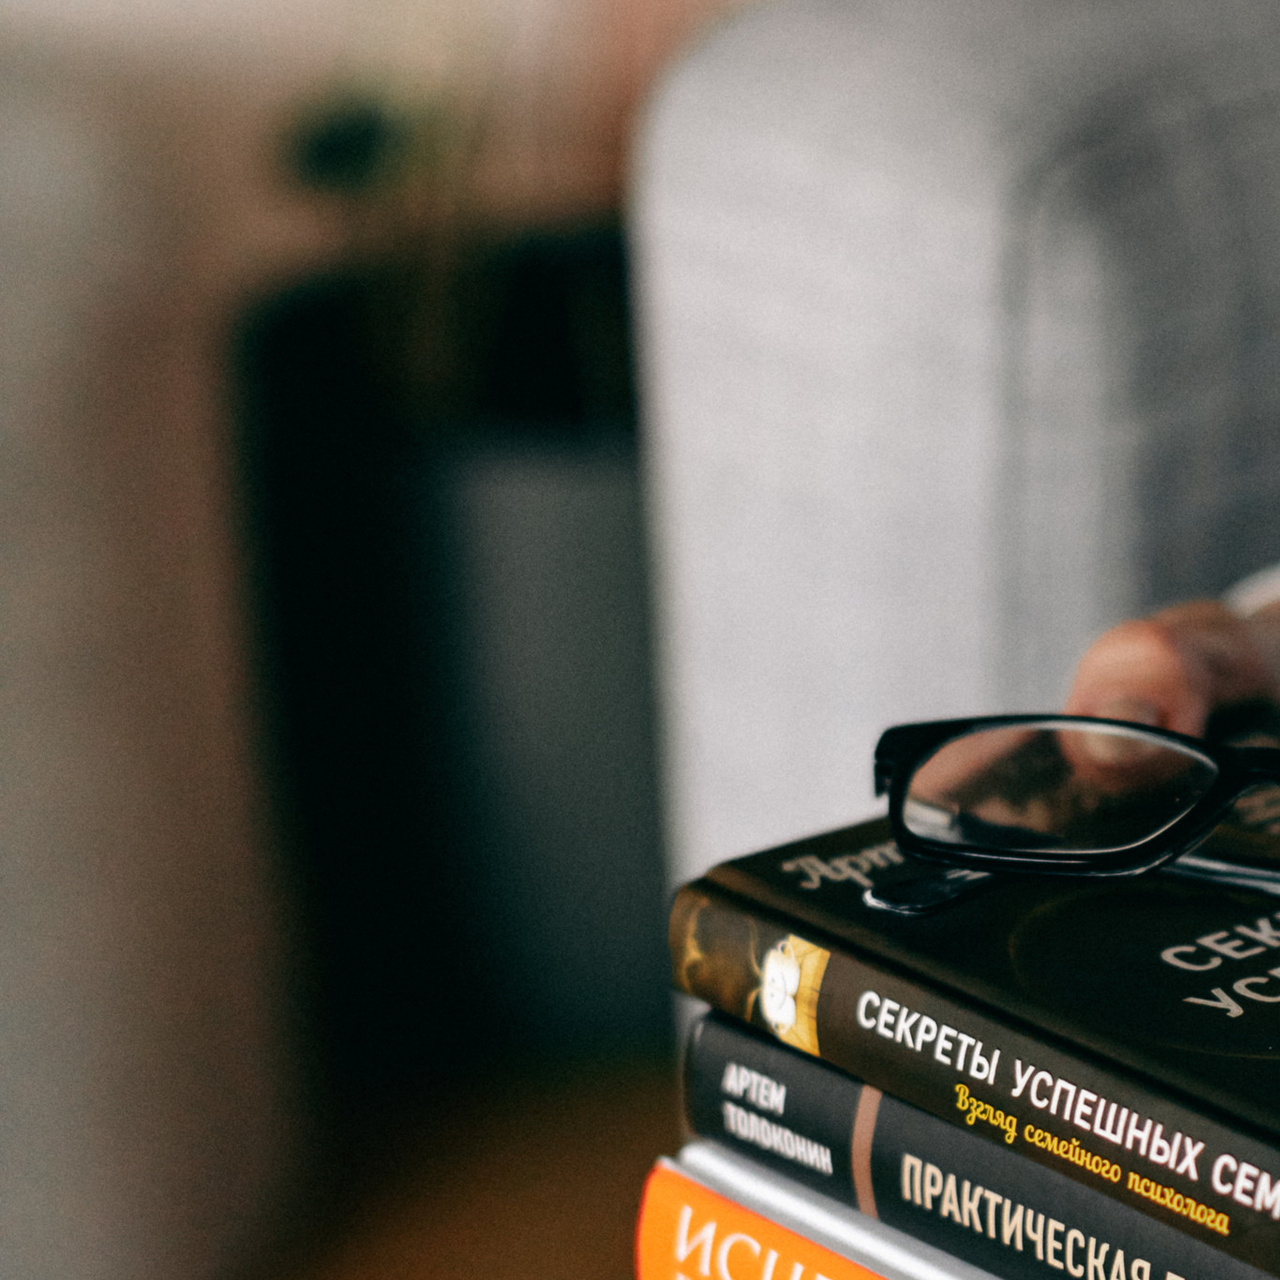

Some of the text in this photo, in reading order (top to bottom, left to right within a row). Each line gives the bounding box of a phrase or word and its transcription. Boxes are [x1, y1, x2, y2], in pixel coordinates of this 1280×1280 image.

[781, 841, 904, 890] Арт
[721, 1062, 787, 1117] АРТЕМ
[857, 990, 1001, 1086] СЕКРЕТЫ
[1010, 1058, 1205, 1181] УСПЕШНЫХ
[722, 1101, 834, 1176] ТОЛОКОНИН
[955, 1083, 1230, 1236] Взгляд семейного психолога
